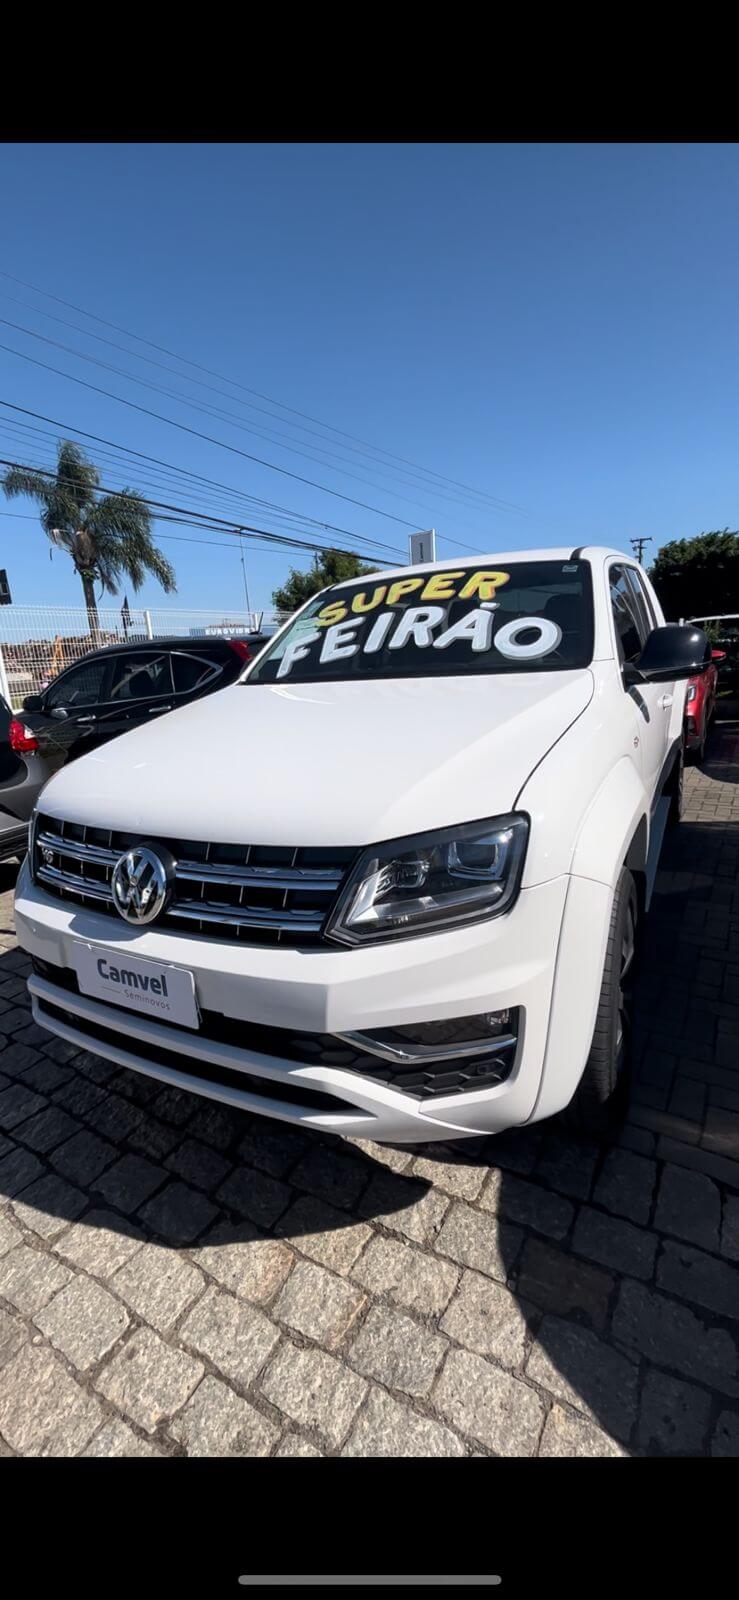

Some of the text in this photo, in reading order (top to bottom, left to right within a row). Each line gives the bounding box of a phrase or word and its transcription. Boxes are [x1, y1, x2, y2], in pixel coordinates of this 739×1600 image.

[315, 571, 510, 627] SUPER
[275, 602, 563, 679] FEIRÃO
[97, 958, 168, 997] Camvel
[124, 988, 170, 1011] Seminovos
